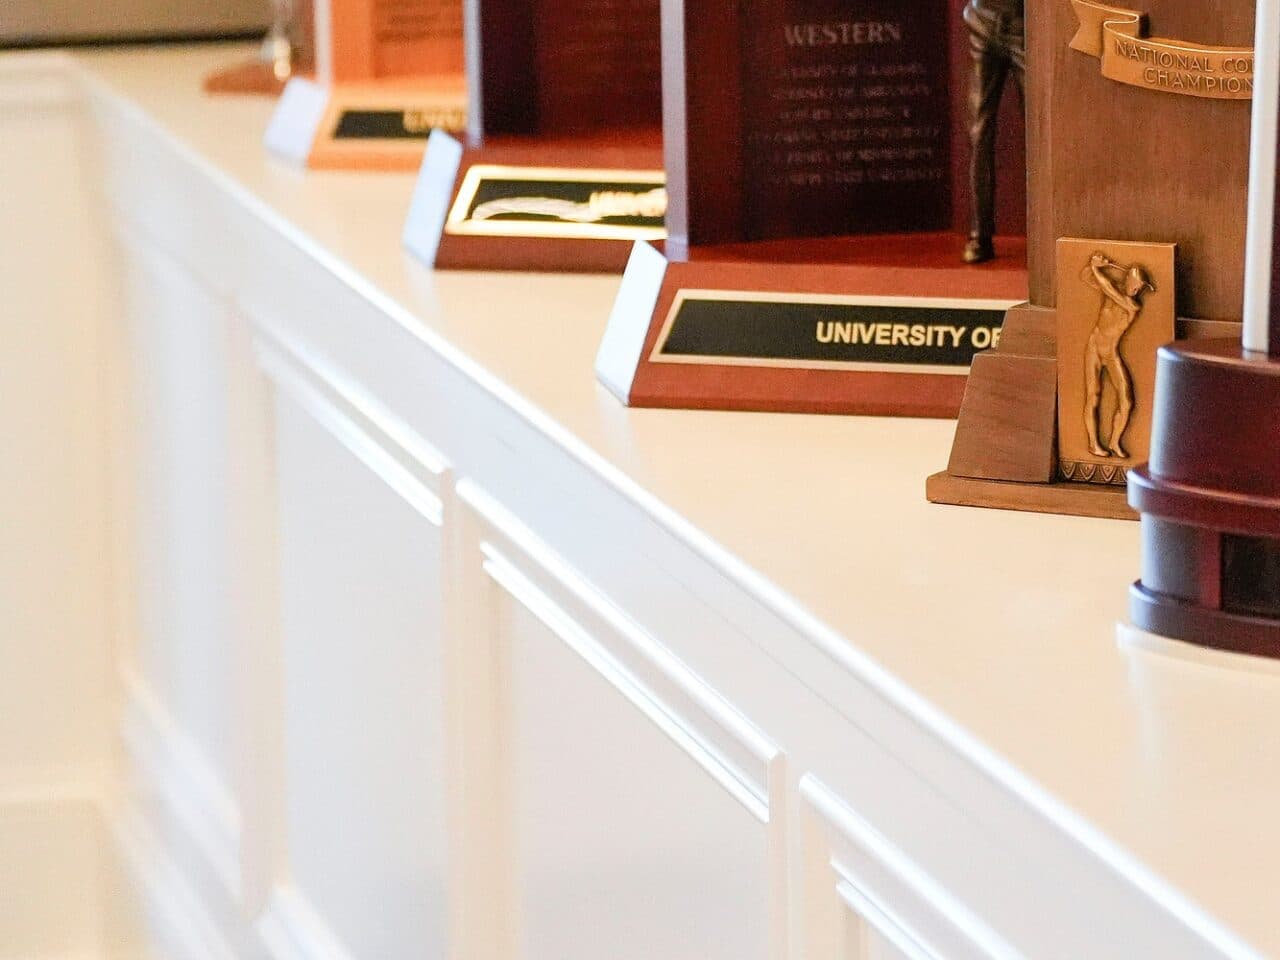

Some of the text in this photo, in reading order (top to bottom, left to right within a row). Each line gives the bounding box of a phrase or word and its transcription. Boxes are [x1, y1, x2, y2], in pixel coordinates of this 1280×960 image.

[784, 22, 902, 46] WESTERN
[1116, 39, 1214, 73] NATIONAL
[816, 321, 1002, 349] UNIVERSITY OF
